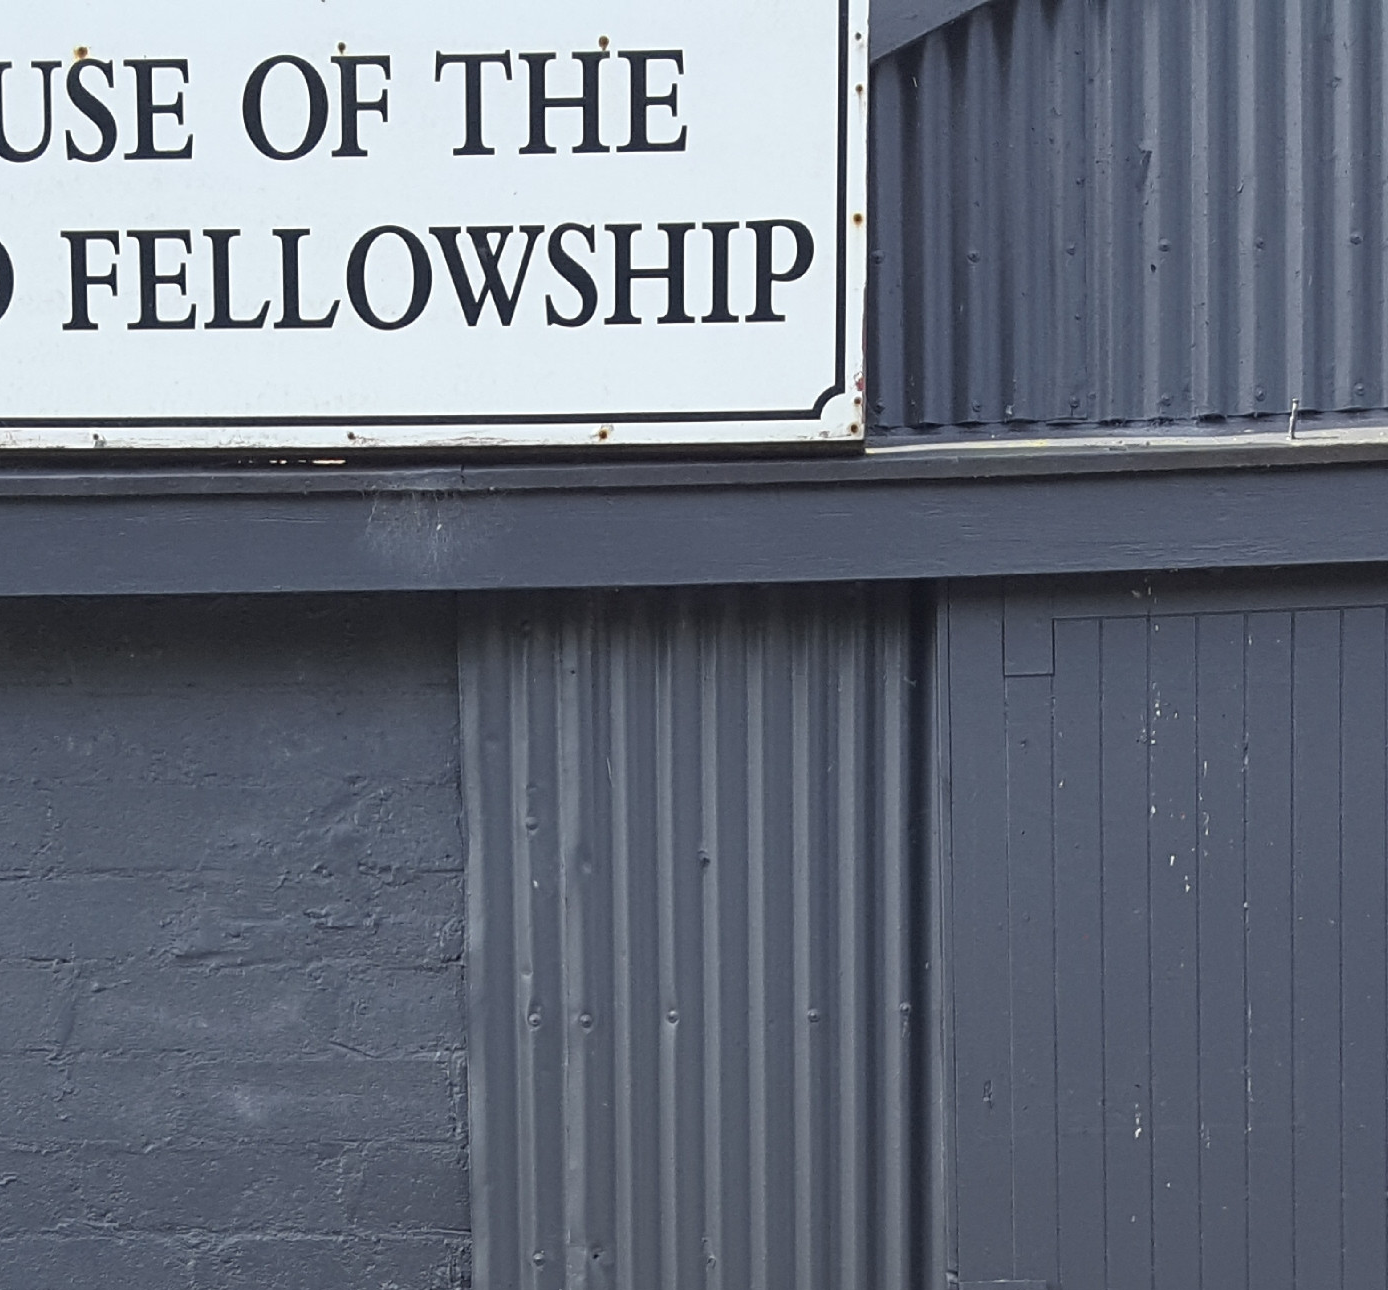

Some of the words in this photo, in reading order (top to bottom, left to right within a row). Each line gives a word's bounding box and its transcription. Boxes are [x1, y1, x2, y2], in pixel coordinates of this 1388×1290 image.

[243, 54, 391, 161] OF
[435, 49, 688, 156] THE
[61, 219, 815, 331] FELLOWSHIP
